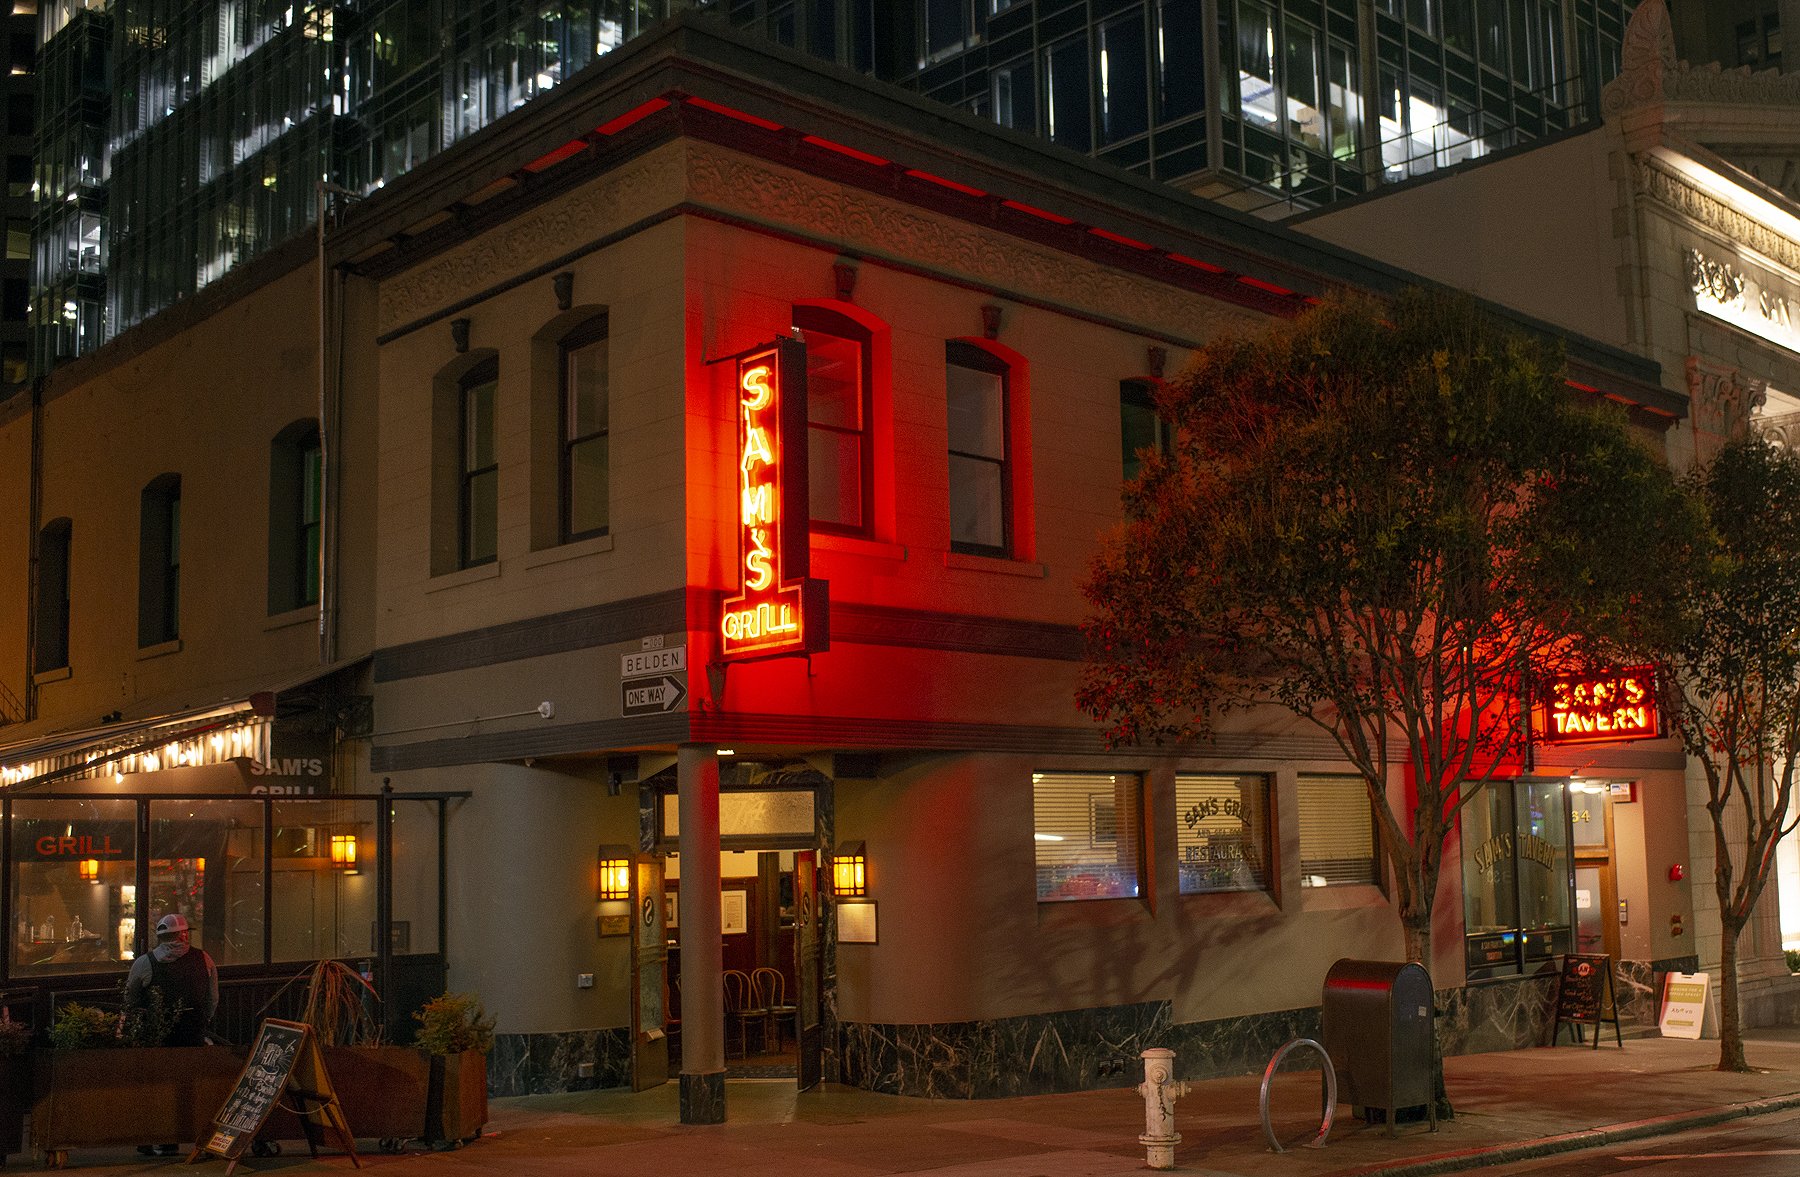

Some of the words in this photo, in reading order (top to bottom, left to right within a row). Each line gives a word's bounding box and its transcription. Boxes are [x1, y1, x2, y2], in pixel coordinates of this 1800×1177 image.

[741, 366, 773, 592] SAM'S
[721, 602, 799, 640] GRILL
[627, 651, 679, 672] BELDEN
[628, 690, 645, 705] ONE
[647, 687, 666, 702] WAY
[1553, 678, 1645, 710] SAM'S
[1553, 706, 1646, 733] TAVERN
[250, 758, 323, 776] SAM'S
[250, 785, 321, 803] GRILL
[1185, 796, 1219, 829] SAM'S
[1224, 797, 1252, 827] GRILL
[35, 836, 122, 855] GRILL
[1185, 844, 1256, 861] RESTAURANT
[1474, 832, 1512, 875] SAM'S
[1518, 832, 1556, 873] TAVERN
